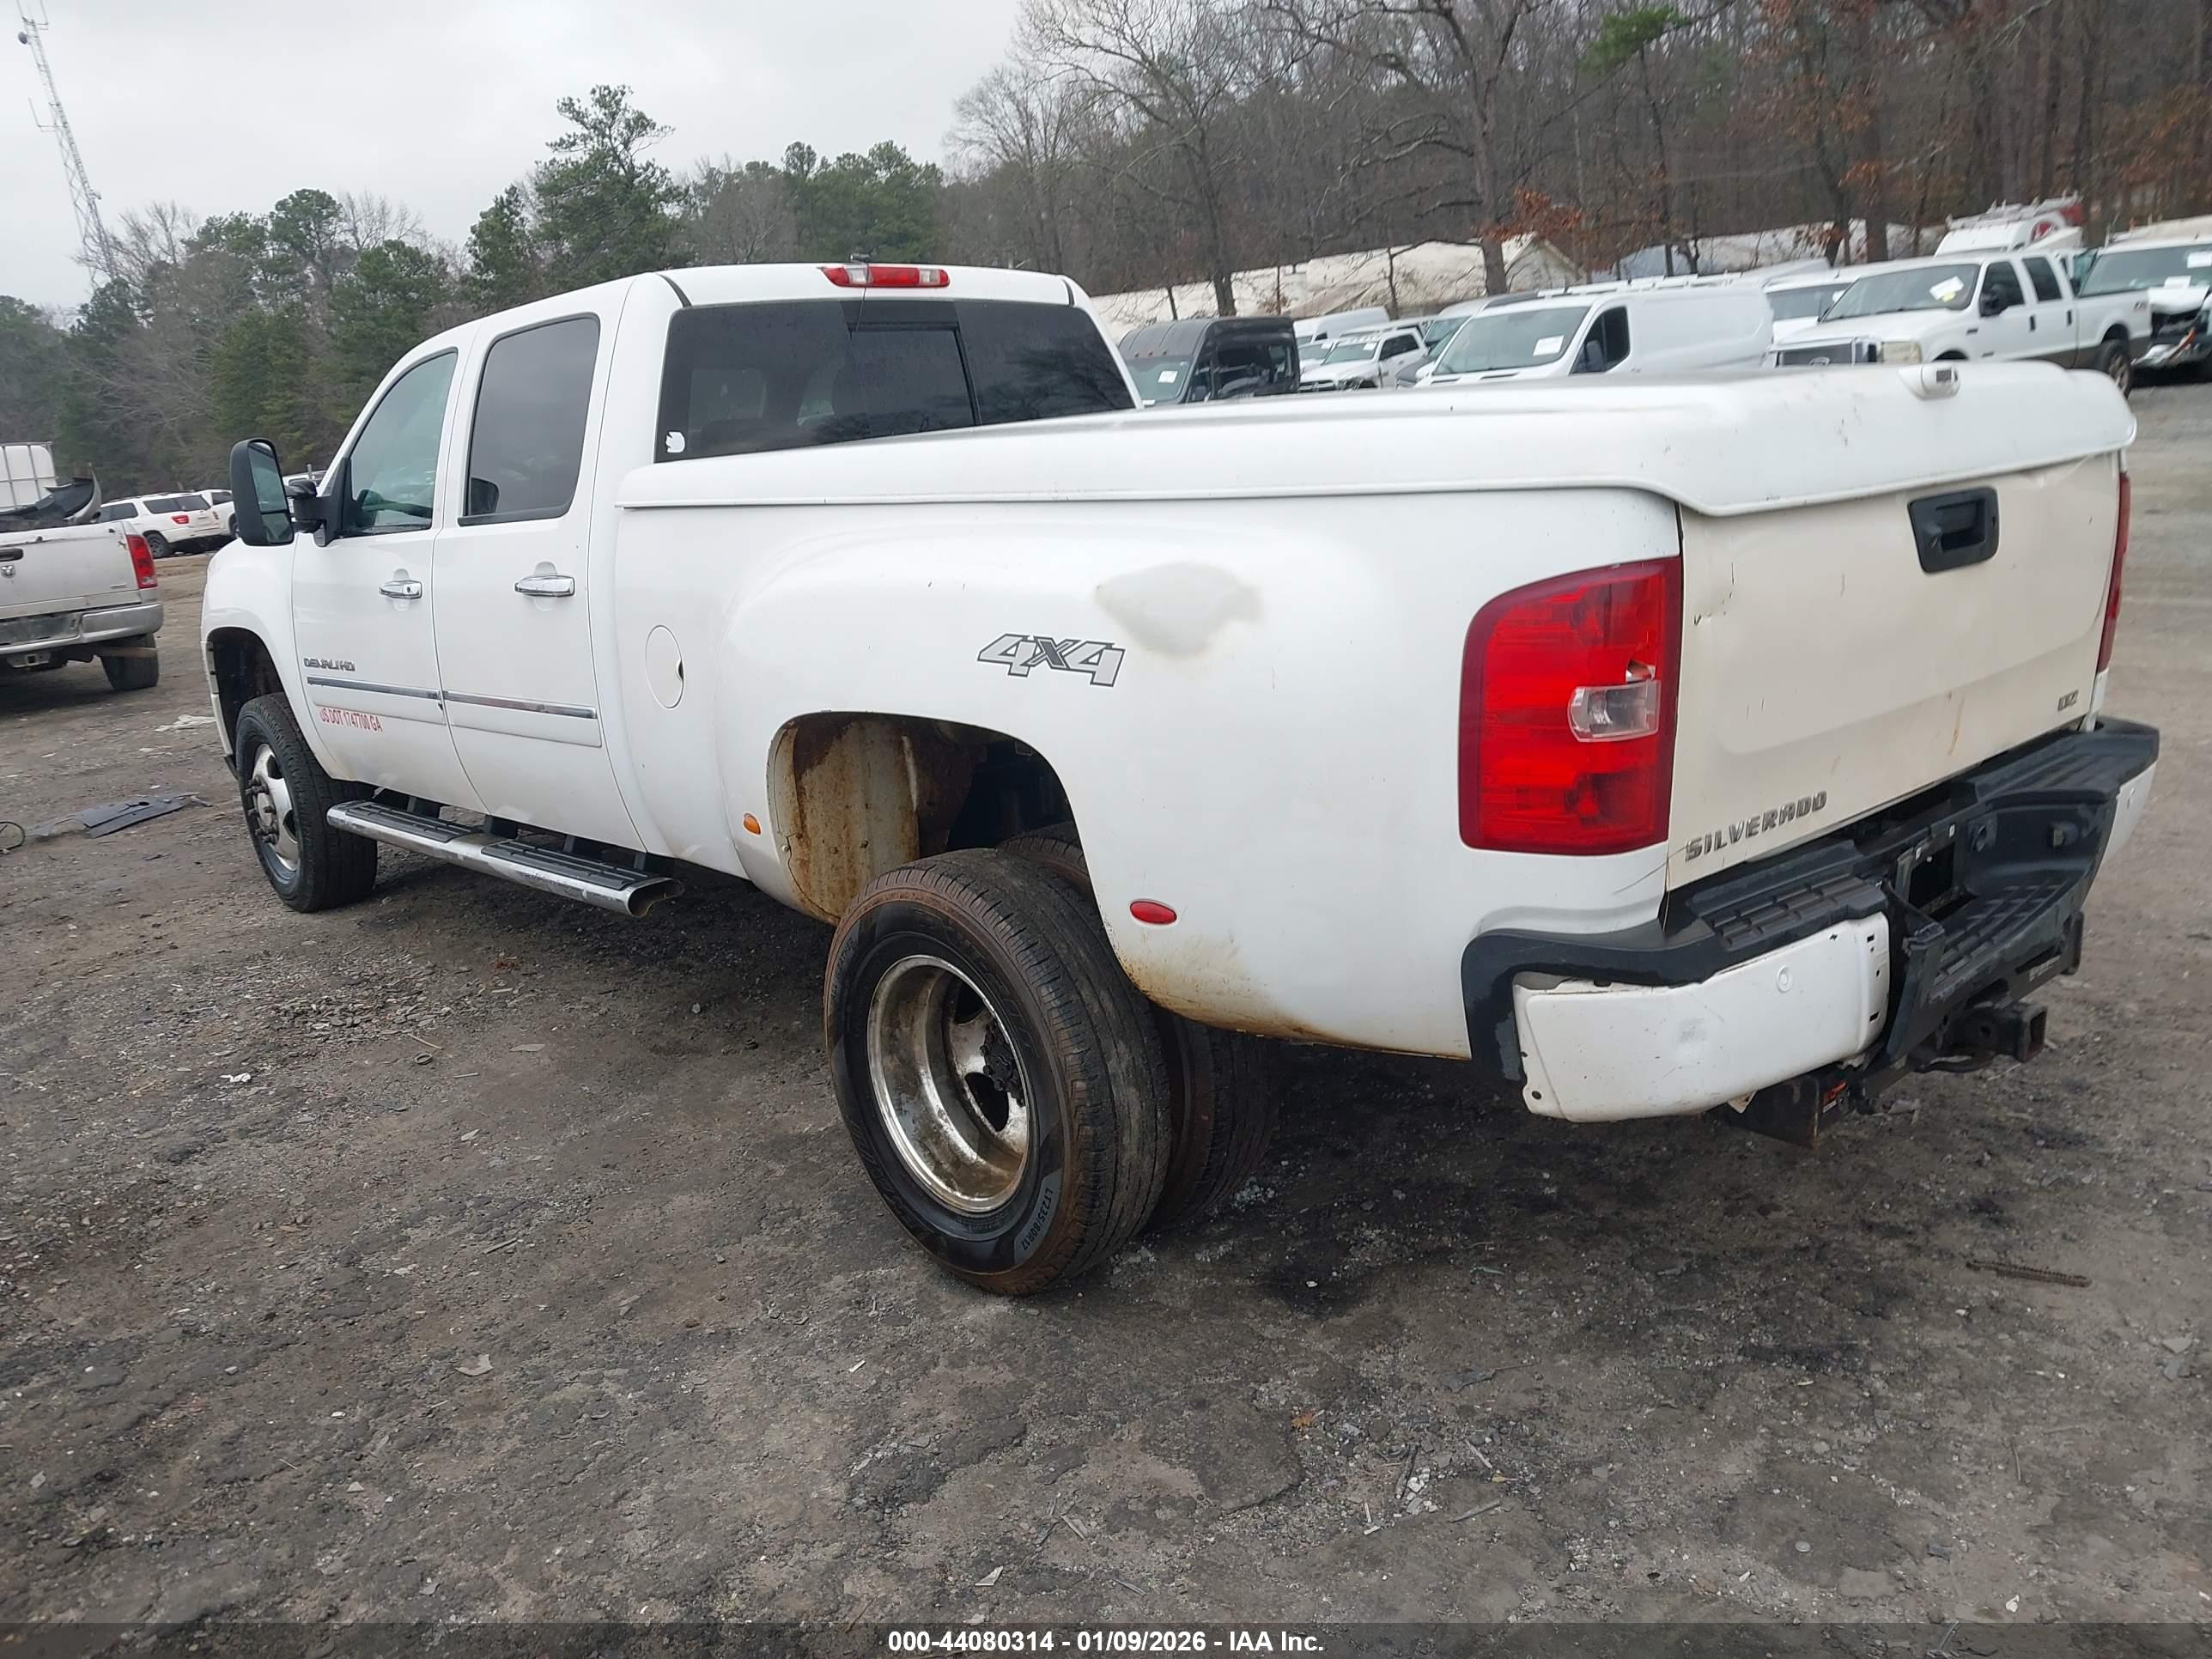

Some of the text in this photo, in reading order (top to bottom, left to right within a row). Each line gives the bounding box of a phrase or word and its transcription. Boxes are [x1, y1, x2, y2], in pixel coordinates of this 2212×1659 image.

[304, 658, 356, 672] DENALI HD
[319, 708, 329, 723] US
[328, 708, 343, 725] DOT
[370, 715, 383, 732] GA
[1685, 790, 1827, 862] SILVERADO
[1021, 1188, 1054, 1251] LT235/80R17
